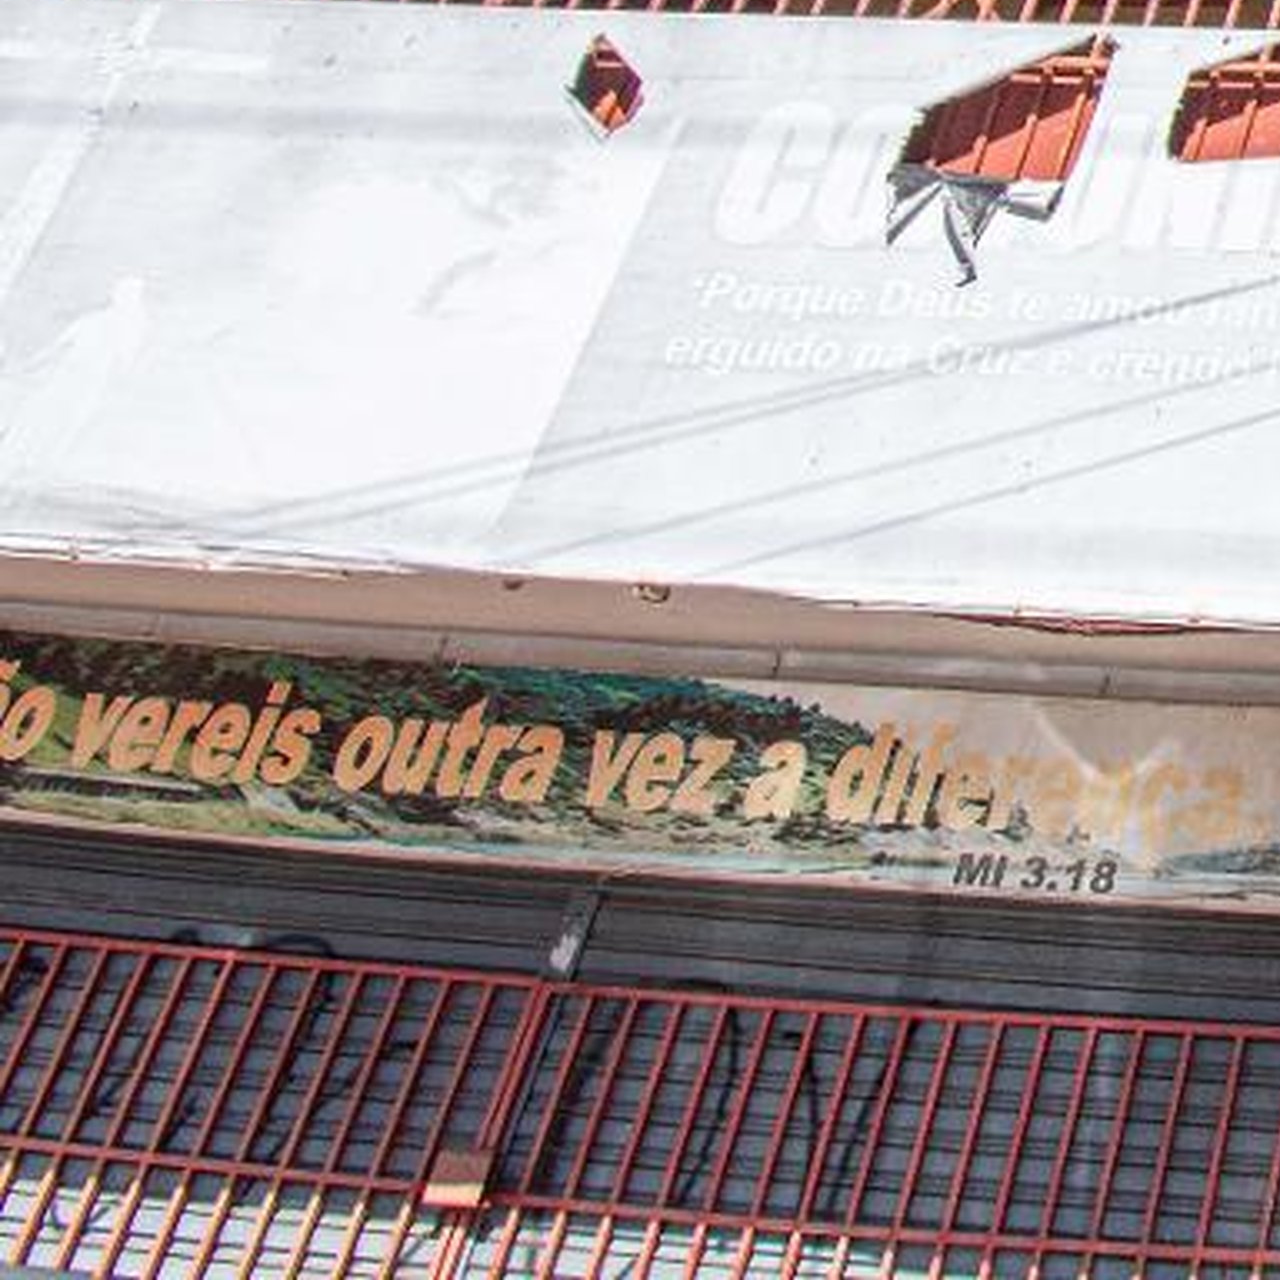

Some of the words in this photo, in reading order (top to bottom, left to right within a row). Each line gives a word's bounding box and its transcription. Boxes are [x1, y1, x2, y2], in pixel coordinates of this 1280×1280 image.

[878, 279, 992, 320] Deus
[664, 332, 840, 377] erguido
[71, 680, 322, 786] vereis
[331, 695, 566, 805] outra
[585, 730, 739, 814] vez
[743, 739, 808, 820] a
